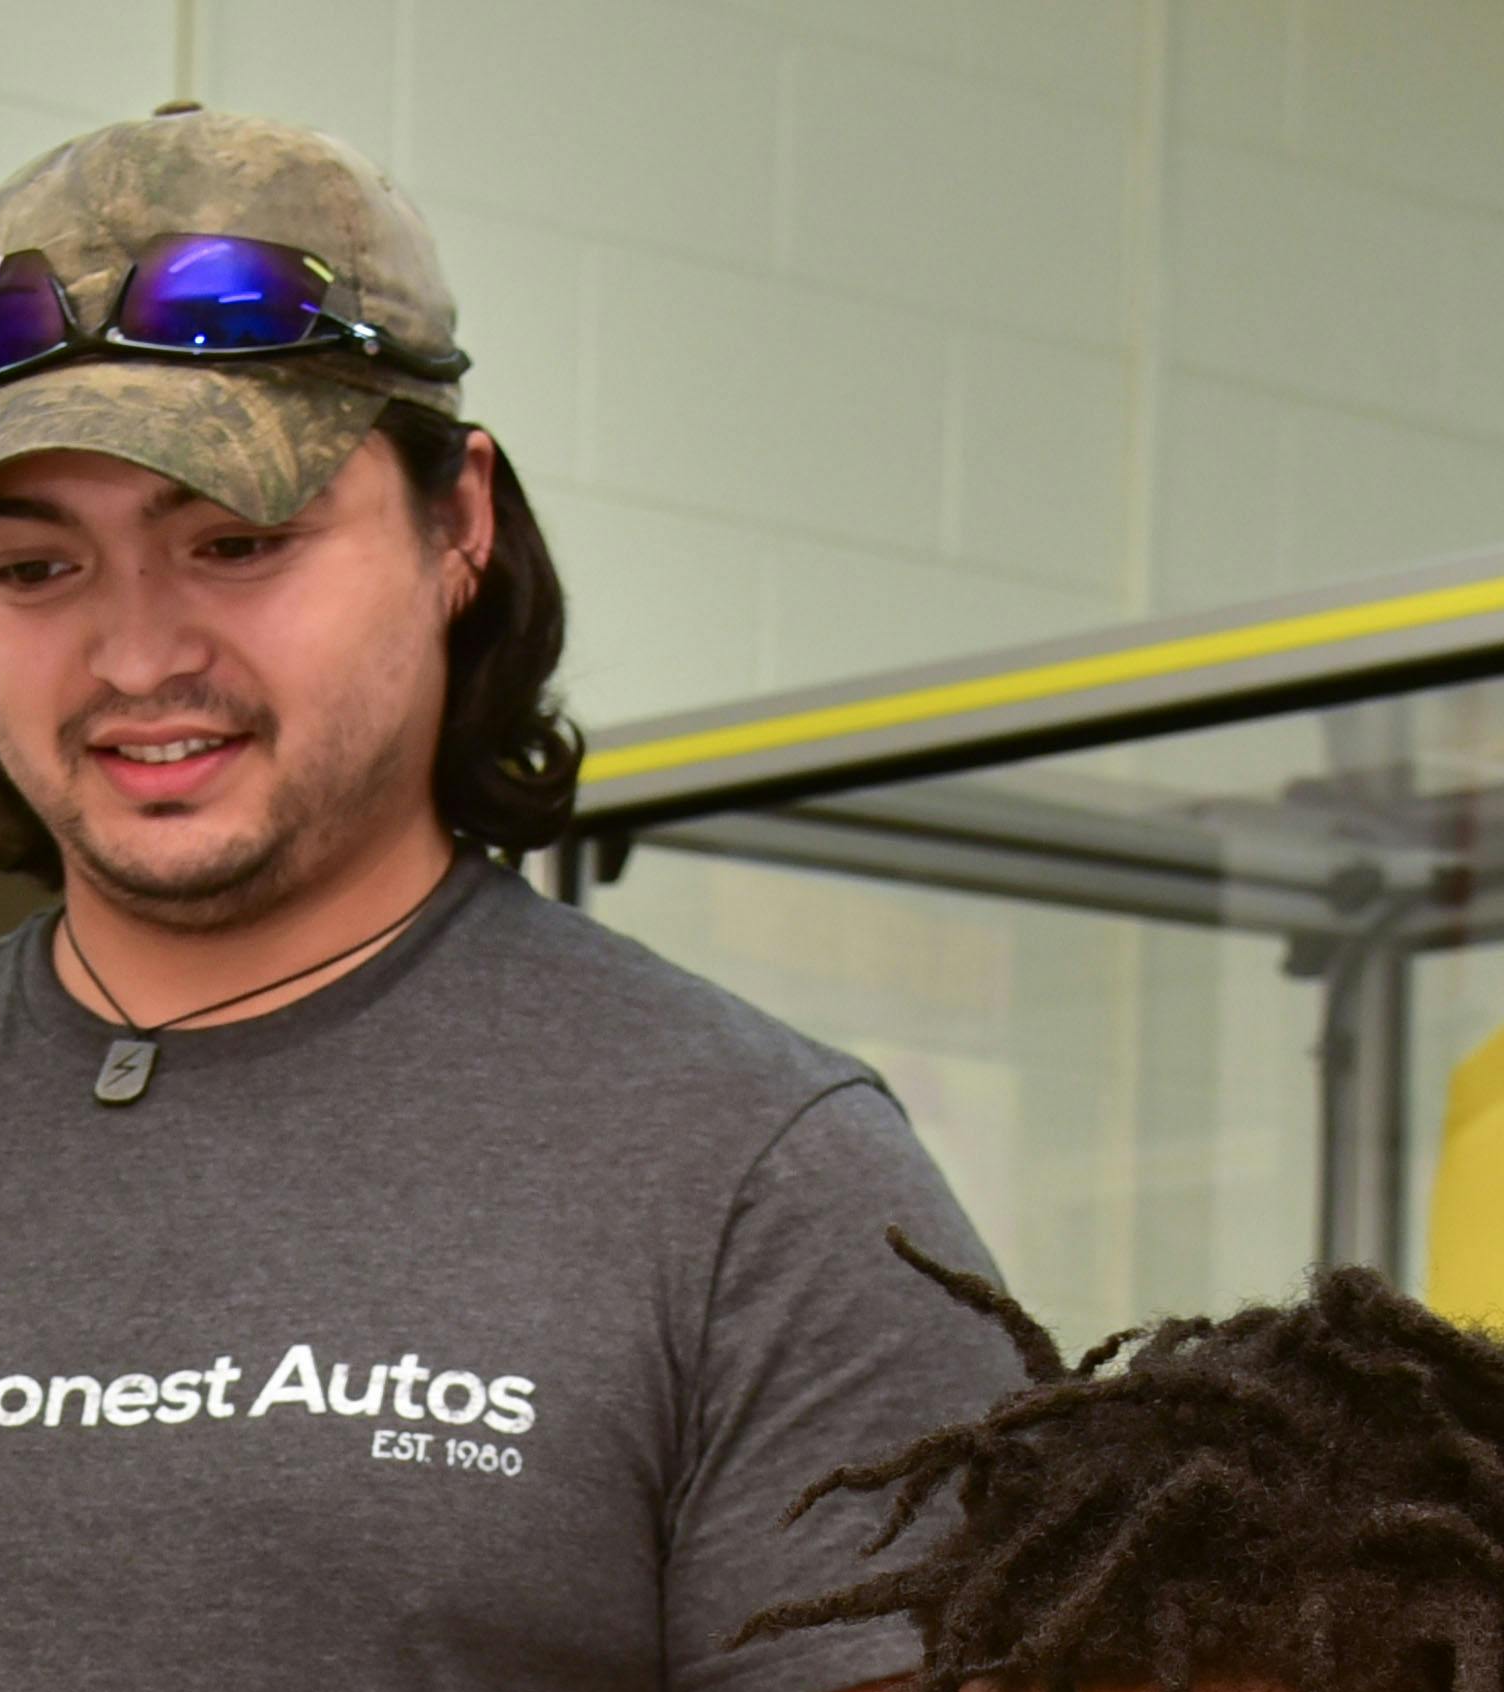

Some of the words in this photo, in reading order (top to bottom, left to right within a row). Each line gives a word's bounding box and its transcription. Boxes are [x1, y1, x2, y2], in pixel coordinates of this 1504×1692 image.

[247, 1344, 537, 1435] Autos
[371, 1430, 433, 1464] EST.
[445, 1438, 524, 1477] 1980
